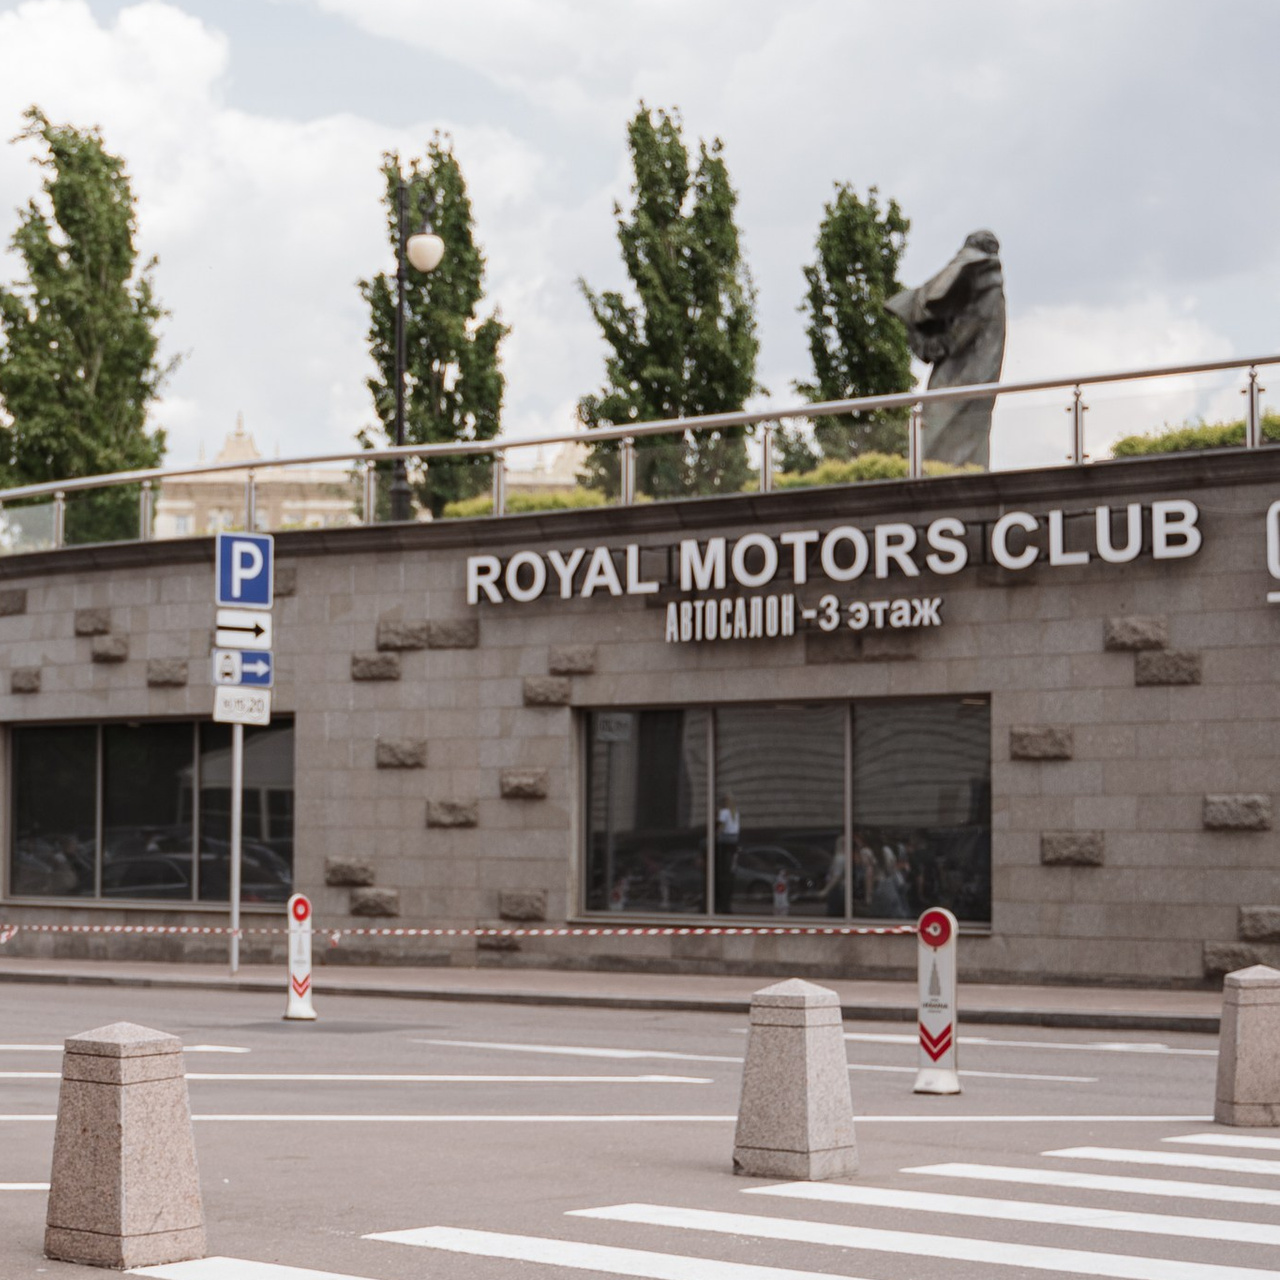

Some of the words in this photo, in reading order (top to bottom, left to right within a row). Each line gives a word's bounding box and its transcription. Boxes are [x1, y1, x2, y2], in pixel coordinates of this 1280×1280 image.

[231, 541, 264, 598] P
[467, 544, 659, 604] ROYAL
[680, 518, 968, 592] MOTORS
[991, 499, 1202, 570] CLUB
[665, 593, 795, 642] АВТОСАЛОН
[847, 598, 942, 630] этаж
